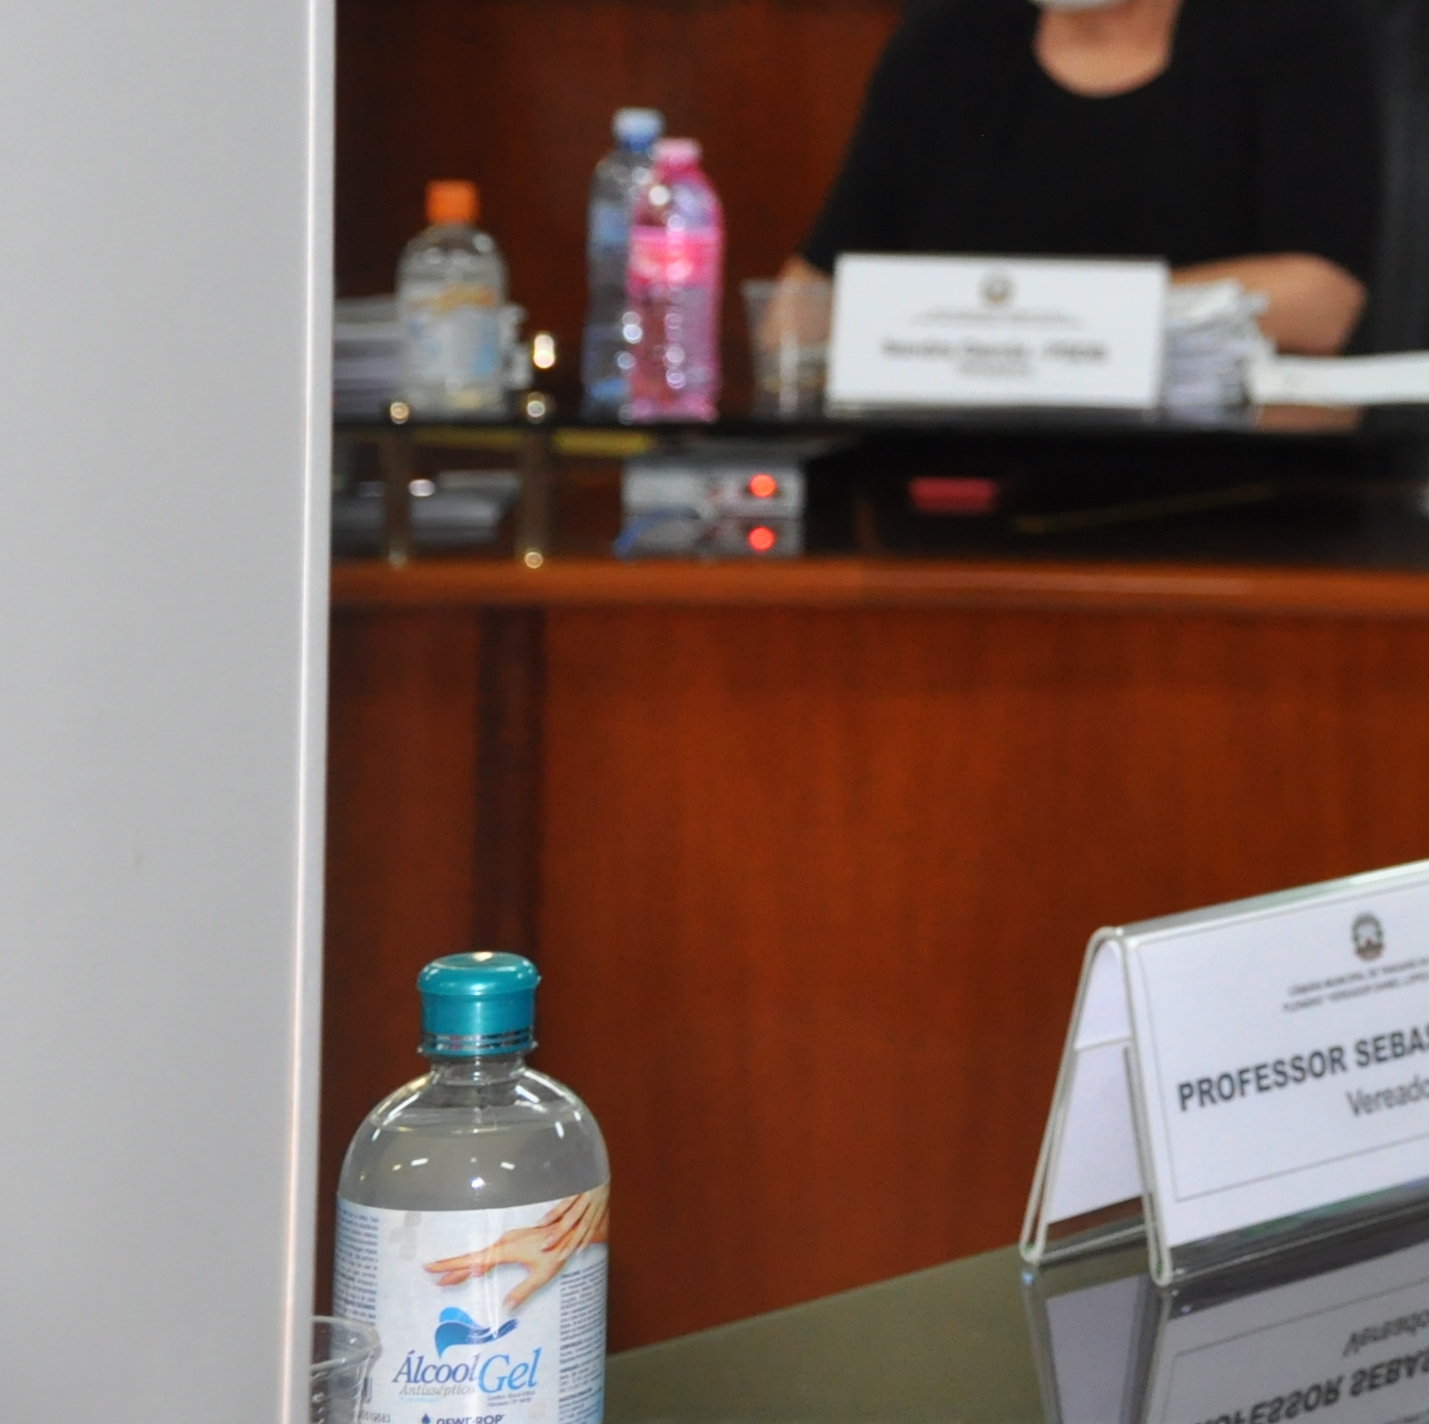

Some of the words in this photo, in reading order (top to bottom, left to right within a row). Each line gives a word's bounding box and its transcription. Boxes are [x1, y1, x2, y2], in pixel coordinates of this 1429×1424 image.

[1178, 1045, 1348, 1112] PROFESSOR
[392, 1349, 479, 1384] Álcool
[478, 1347, 542, 1394] Gel
[399, 1383, 475, 1398] Antisséptico
